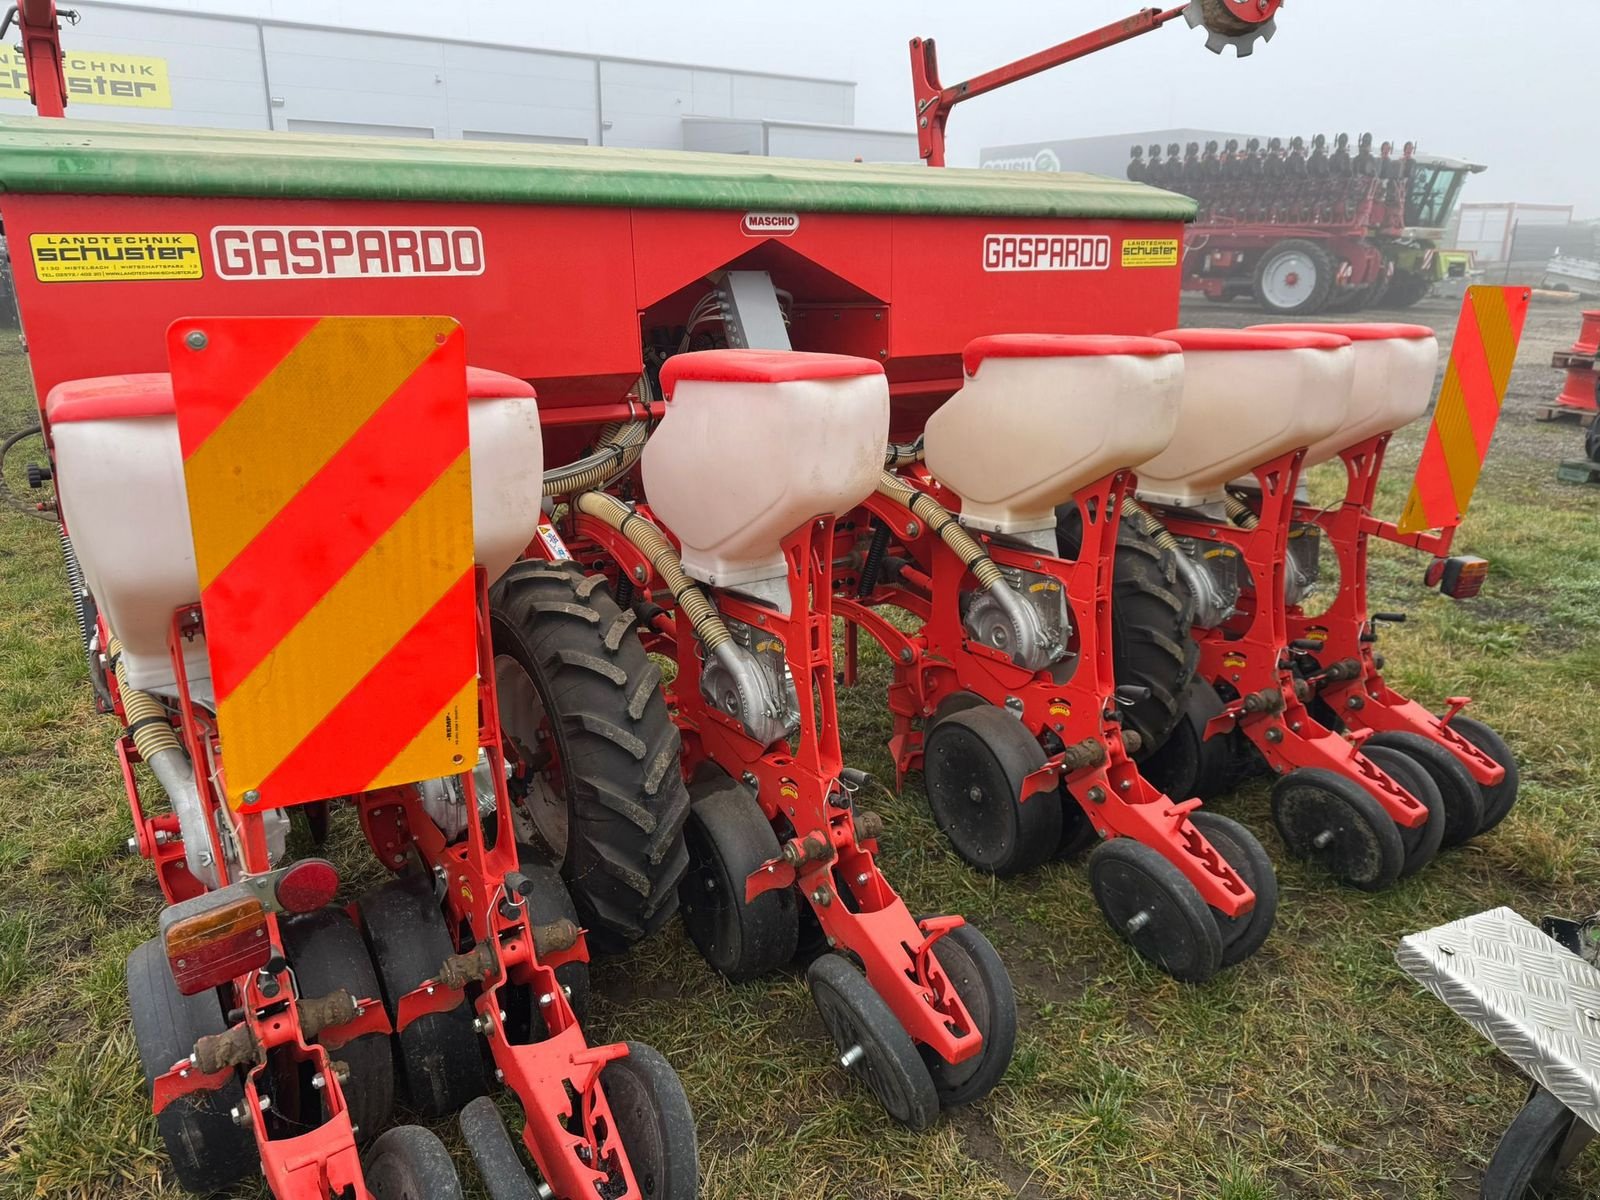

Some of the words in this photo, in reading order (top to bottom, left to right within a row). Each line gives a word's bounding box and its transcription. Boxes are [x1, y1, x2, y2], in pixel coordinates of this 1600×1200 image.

[748, 216, 795, 226] MASCHIO
[47, 236, 182, 245] LANDTECHNIK
[36, 244, 196, 261] schuster
[215, 230, 482, 275] GASPARDO
[985, 238, 1109, 268] GASPARDO
[1123, 246, 1176, 255] schuster
